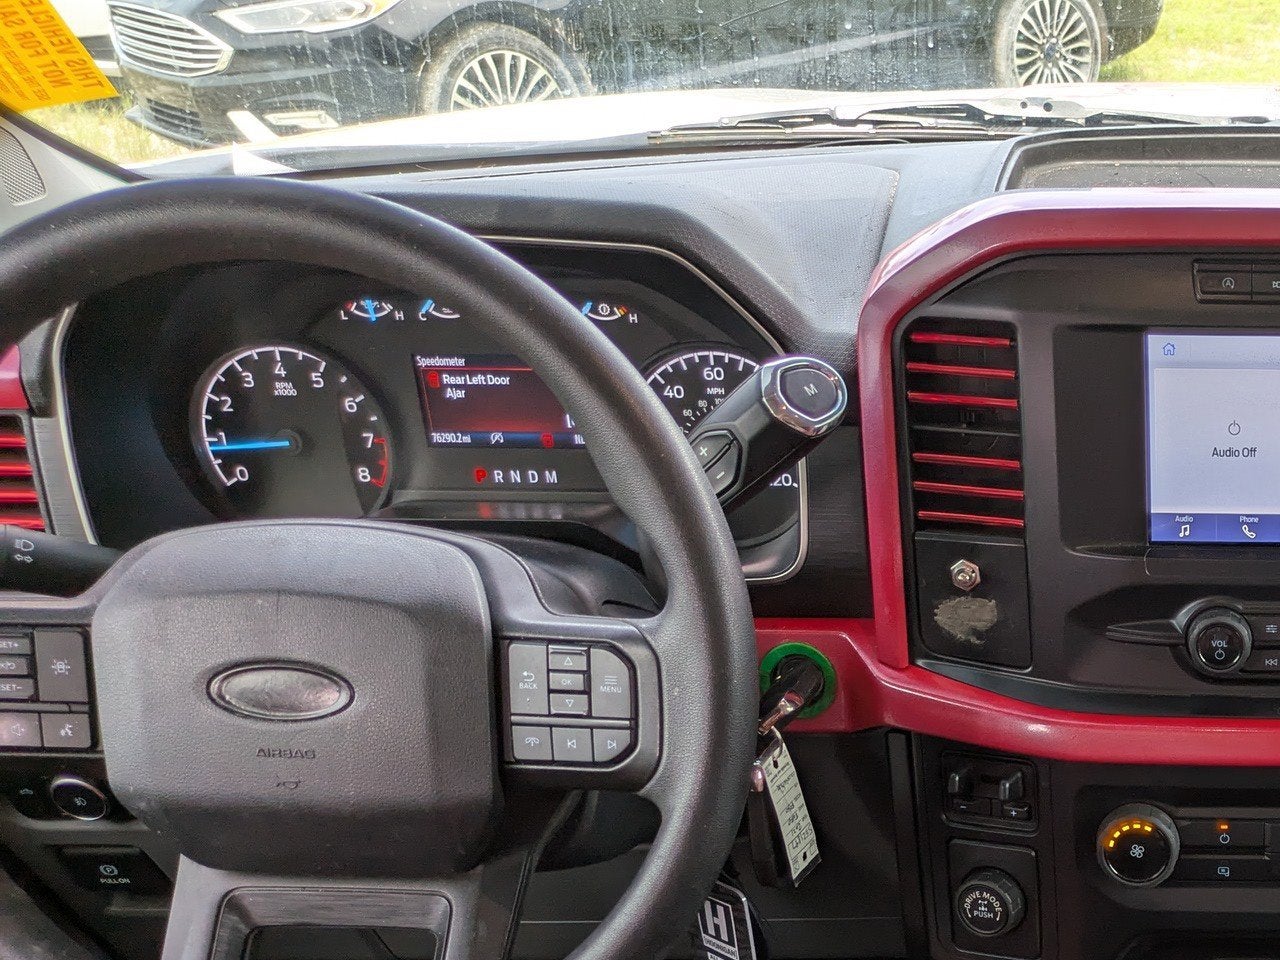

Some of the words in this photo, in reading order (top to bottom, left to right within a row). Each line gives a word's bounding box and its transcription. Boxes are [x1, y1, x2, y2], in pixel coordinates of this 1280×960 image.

[629, 313, 638, 323] H
[416, 356, 466, 367] Speedometer
[274, 363, 287, 377] 4
[703, 368, 725, 381] 60
[241, 373, 255, 388] 3
[311, 373, 324, 388] 5
[443, 374, 465, 385] Rear
[466, 374, 486, 385] Left
[487, 374, 510, 385] Door
[446, 388, 466, 399] Ajar
[663, 385, 685, 399] 40
[706, 387, 725, 395] MPH
[803, 384, 818, 397] M
[220, 397, 233, 412] 2
[345, 398, 357, 413] 6
[362, 433, 374, 448] 7
[1211, 447, 1240, 458] Audio
[1242, 447, 1258, 458] Off
[236, 467, 249, 482] 0
[358, 467, 371, 482] 8
[475, 468, 488, 483] P
[494, 470, 504, 483] R
[510, 470, 521, 483] N
[528, 470, 539, 483] D
[545, 470, 558, 484] M
[769, 473, 791, 487] 20
[1175, 515, 1193, 523] Audio
[600, 685, 622, 693] MENU
[964, 891, 981, 909] DRIVE
[982, 891, 1003, 913] MODE
[973, 910, 994, 919] PUSH
